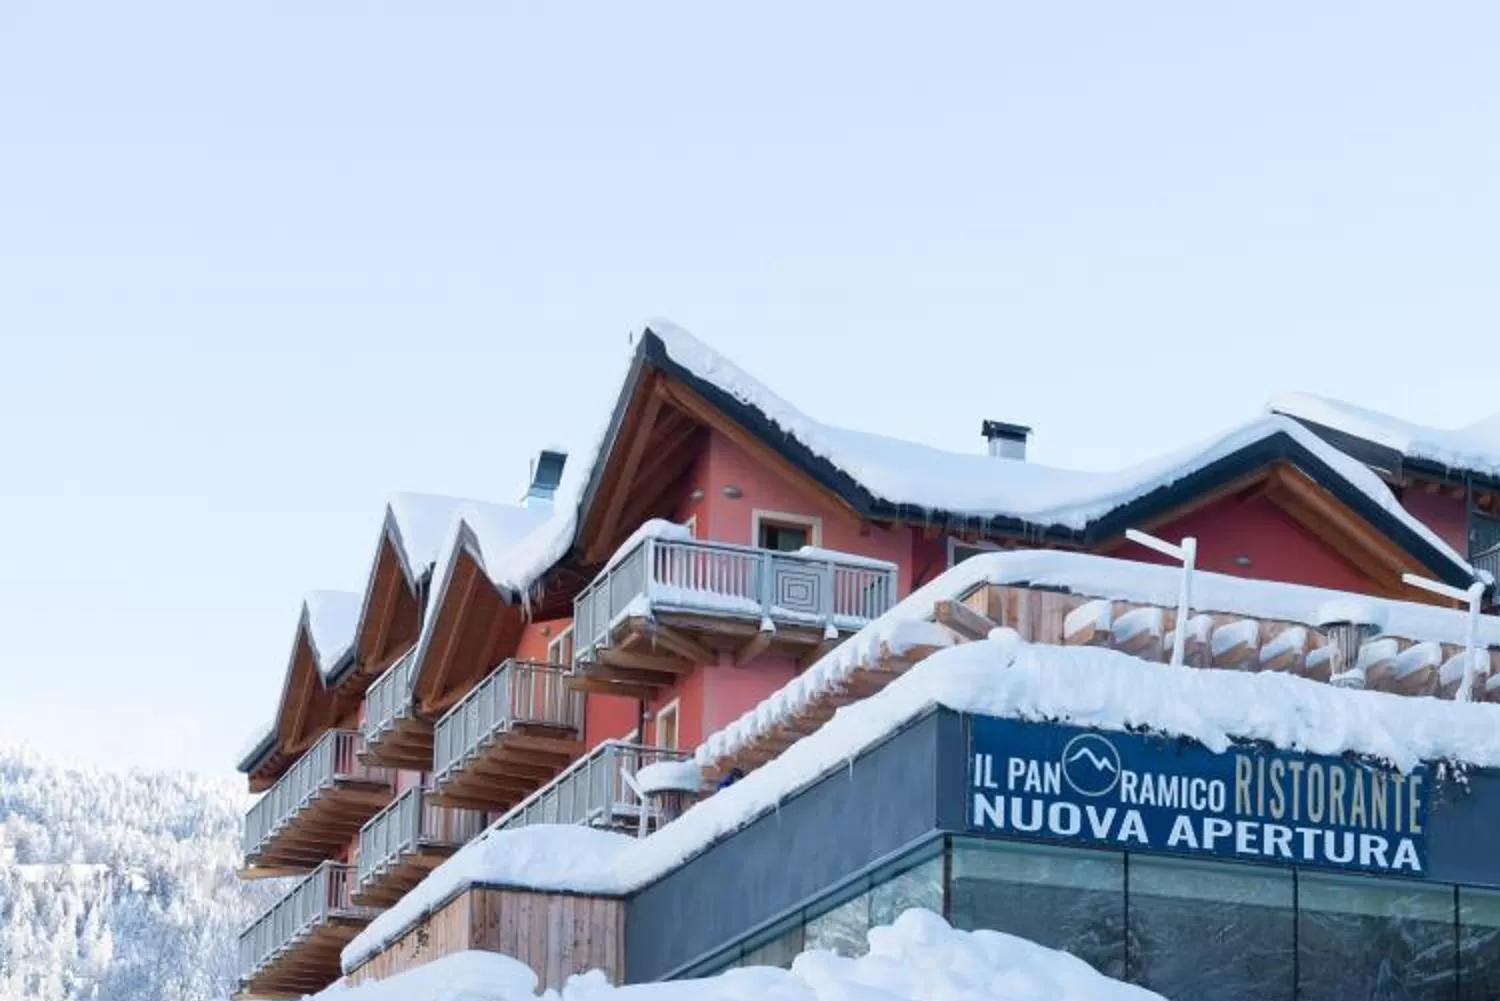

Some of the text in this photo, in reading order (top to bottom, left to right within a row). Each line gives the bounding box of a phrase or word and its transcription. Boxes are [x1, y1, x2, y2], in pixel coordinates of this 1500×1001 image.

[973, 753, 998, 789] IL
[1235, 753, 1422, 834] RISTORANTE
[973, 793, 1422, 872] NUOVA APERTURA
